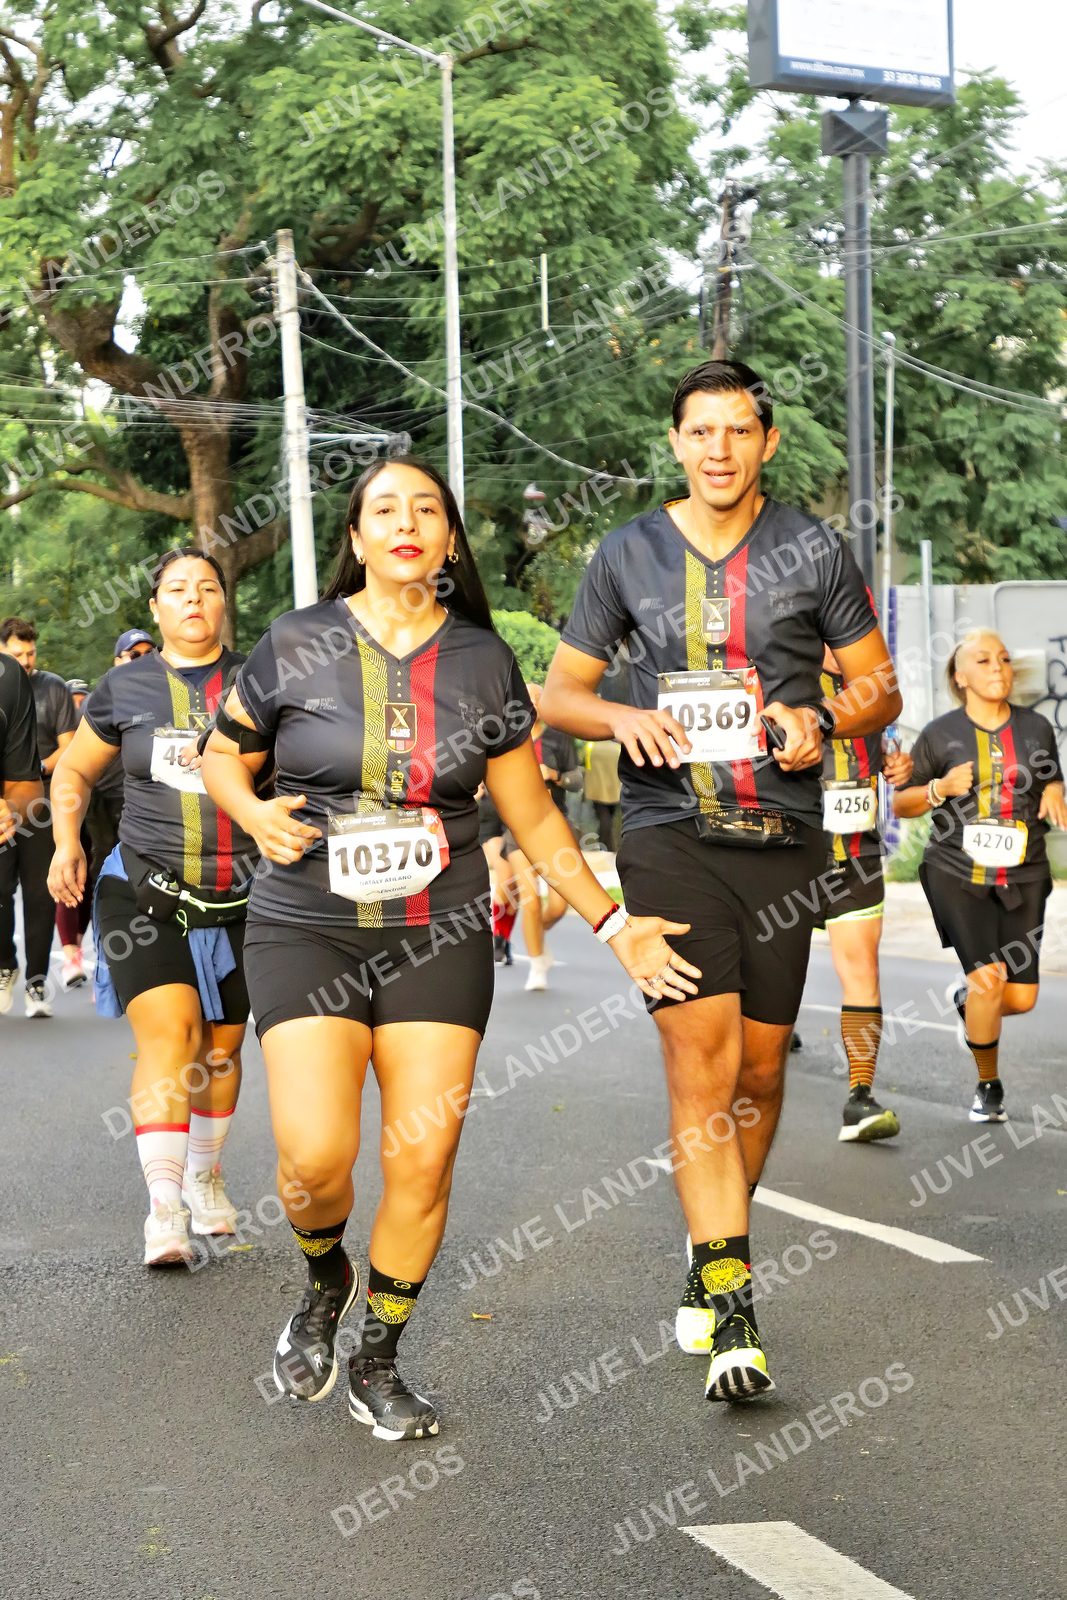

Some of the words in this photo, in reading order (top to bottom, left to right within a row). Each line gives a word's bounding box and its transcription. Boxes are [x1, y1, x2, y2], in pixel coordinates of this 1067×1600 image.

[834, 795, 870, 814] 4256
[972, 831, 1014, 851] 4270
[334, 838, 433, 877] 10370
